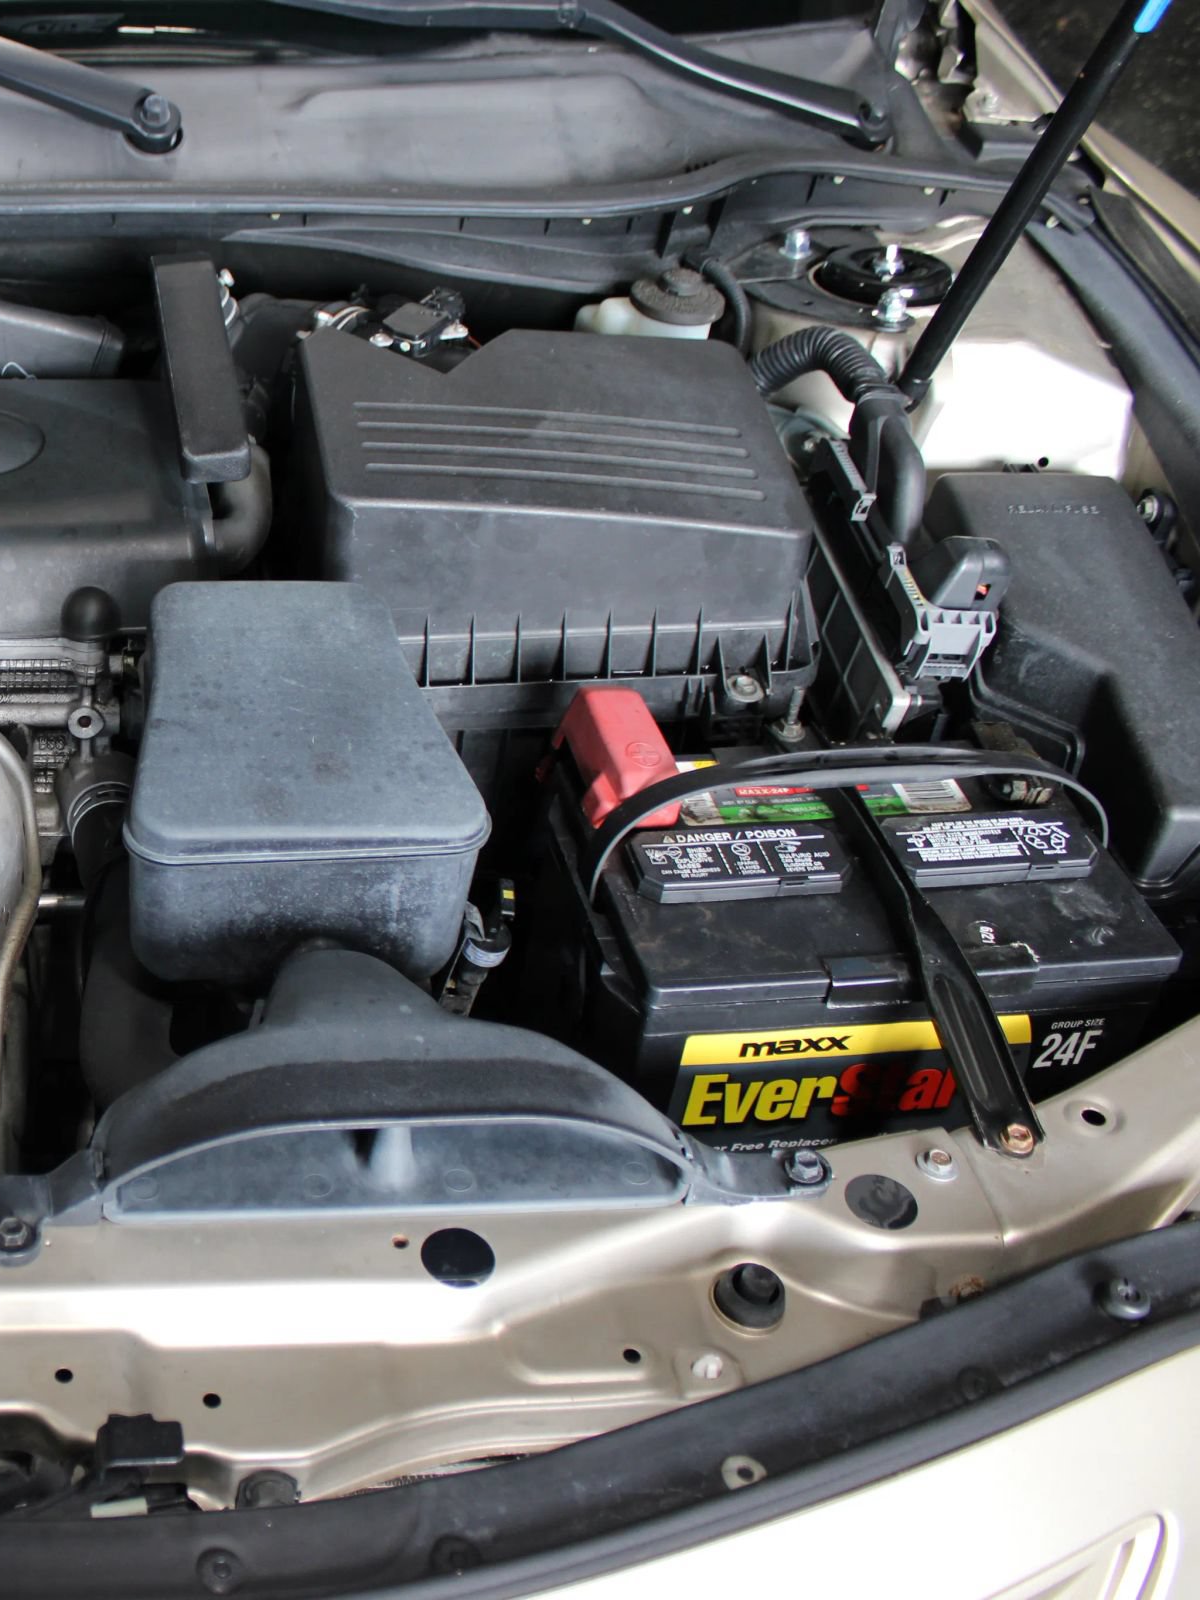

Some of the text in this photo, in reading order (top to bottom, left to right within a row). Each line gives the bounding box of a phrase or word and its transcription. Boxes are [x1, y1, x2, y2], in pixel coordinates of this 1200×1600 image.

[676, 828, 797, 844] DANGER / POISON
[1051, 1018, 1106, 1030] GROUP SIZE
[737, 1035, 851, 1057] maxx
[1032, 1029, 1104, 1068] 24F
[681, 1062, 958, 1126] EverStar
[730, 1142, 765, 1152] Free
